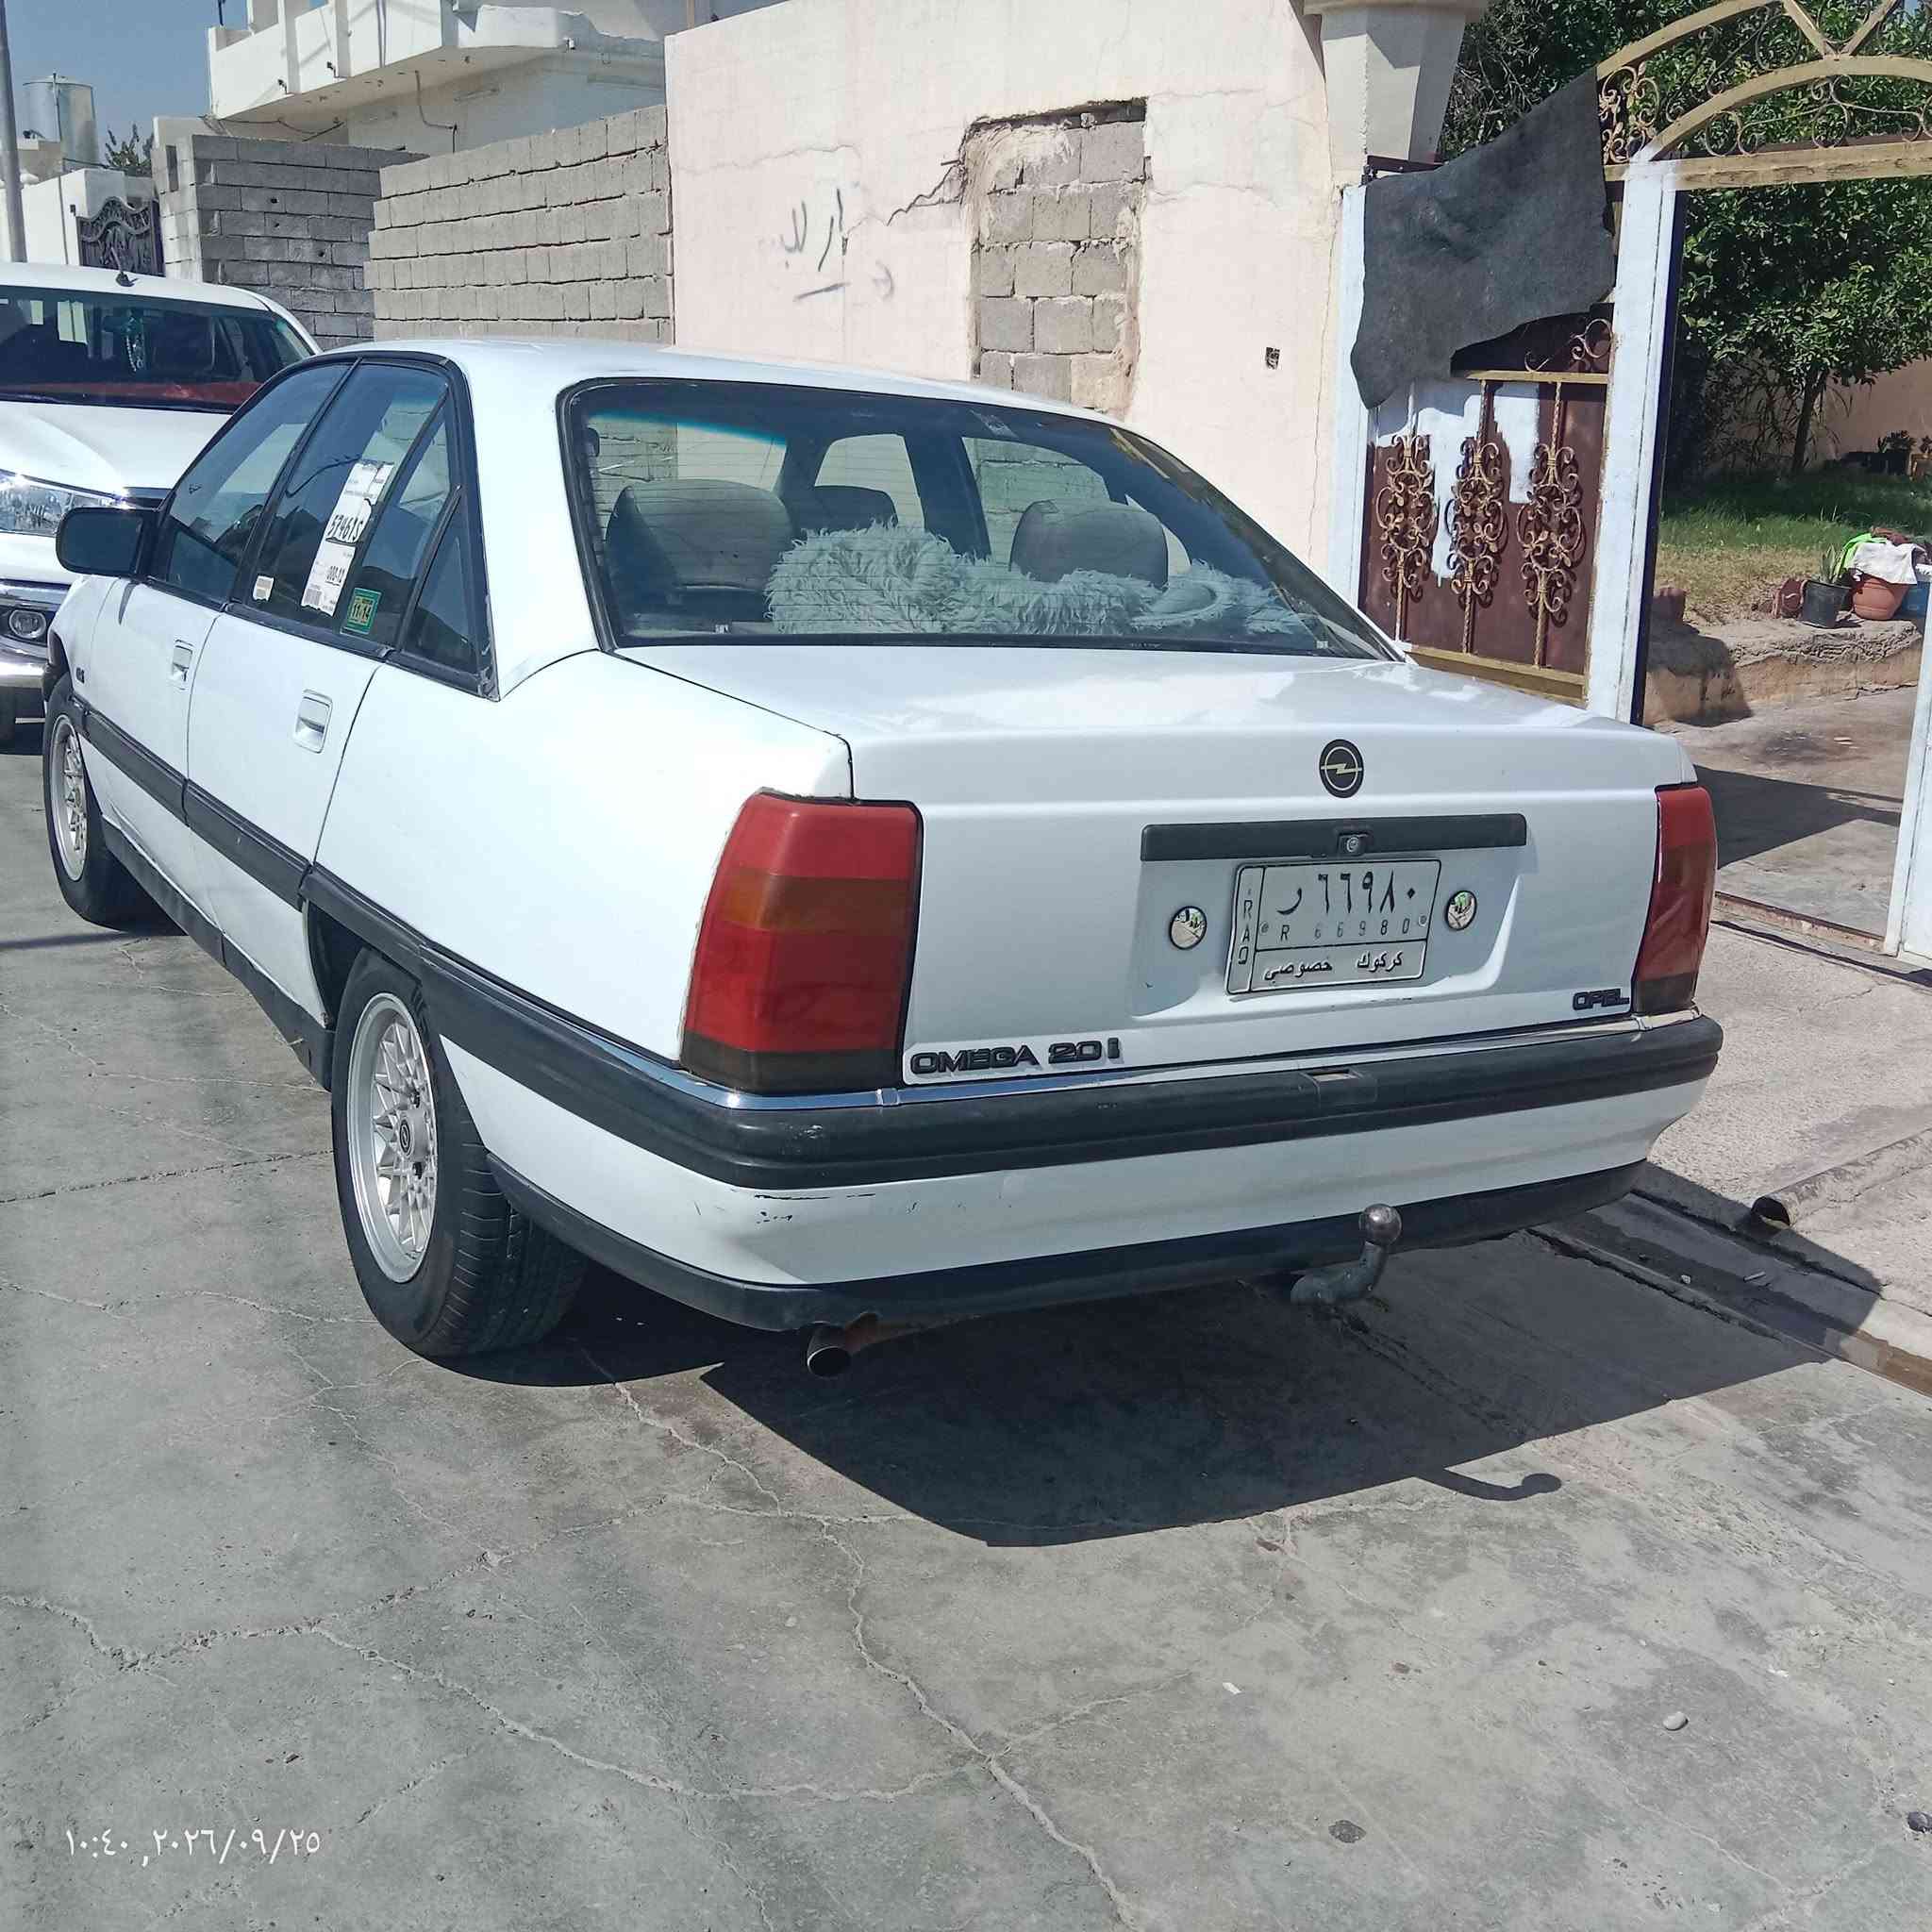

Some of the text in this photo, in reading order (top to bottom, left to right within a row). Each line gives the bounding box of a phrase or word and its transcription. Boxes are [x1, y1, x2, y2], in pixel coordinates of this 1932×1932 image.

[1318, 869, 1417, 914] ٦٦٩٨٠
[1280, 924, 1291, 942] R
[1356, 951, 1404, 974] كركوك
[1573, 988, 1630, 1011] OPEL
[910, 1044, 1041, 1075] OMEGA
